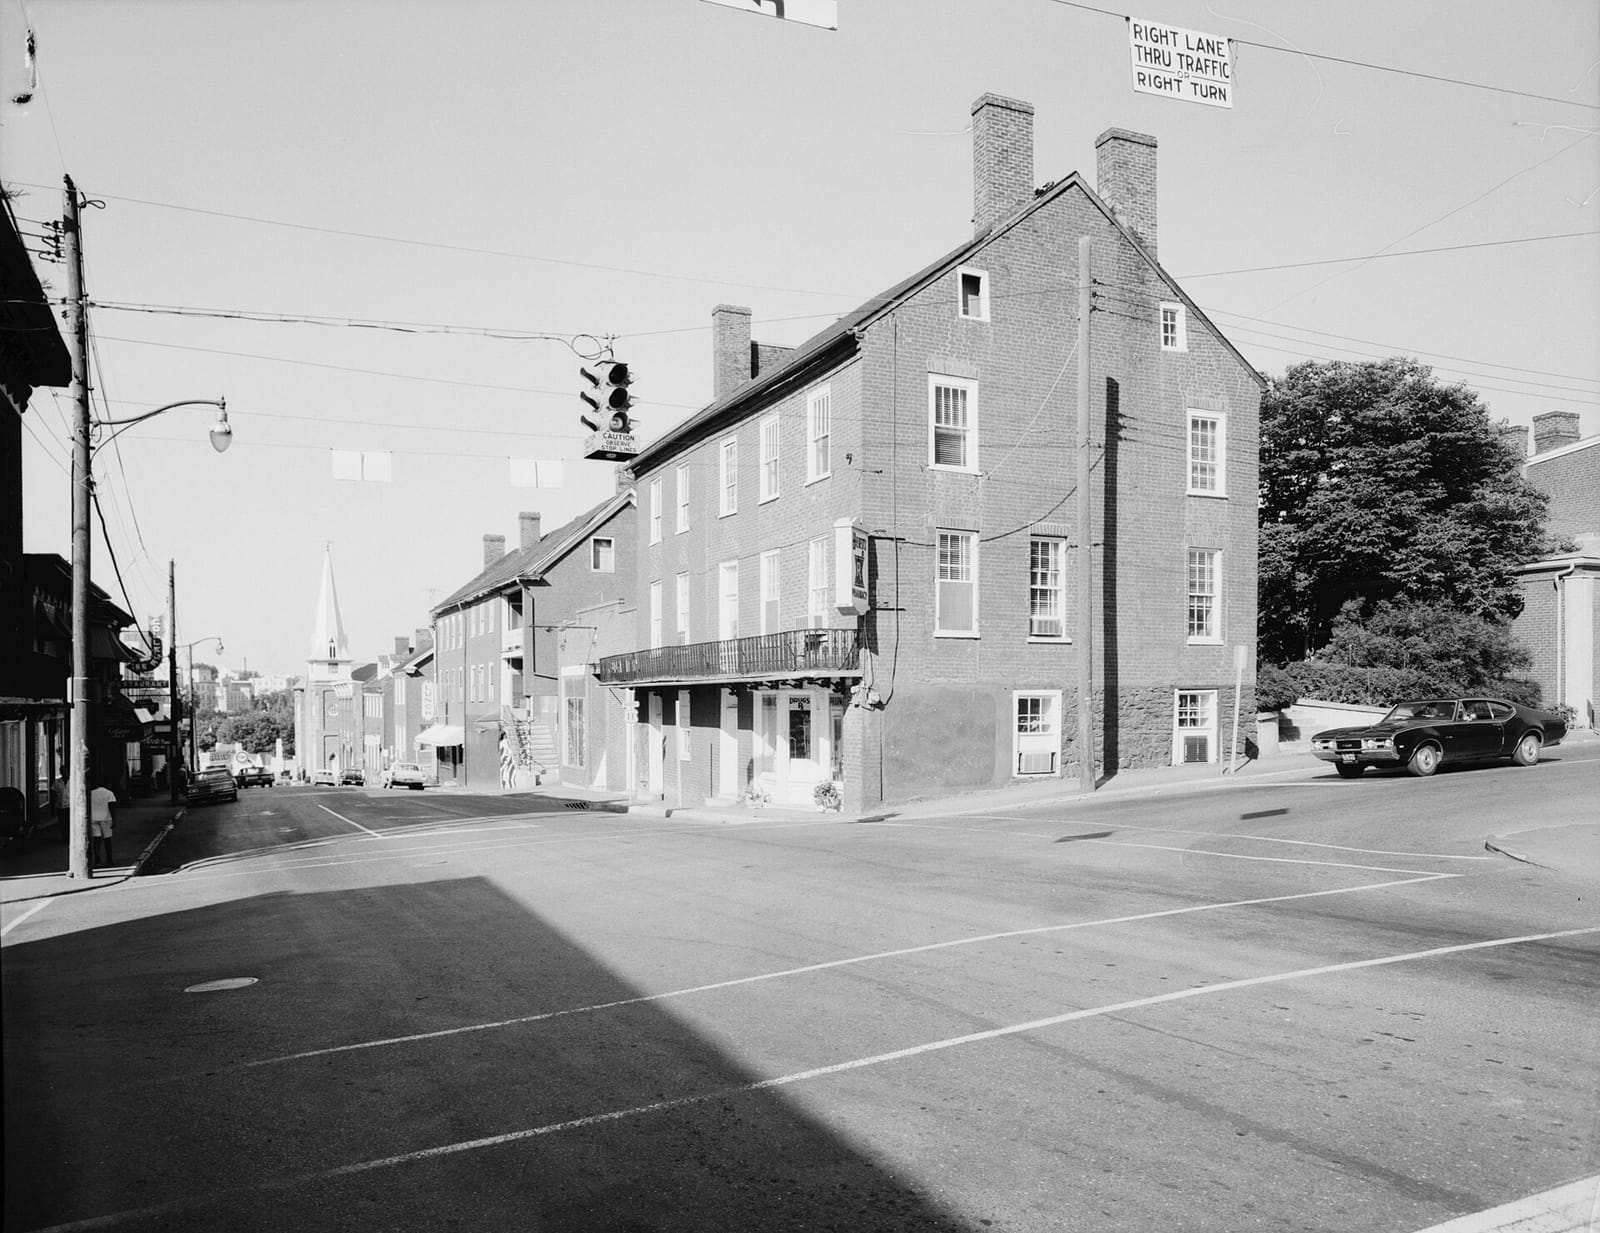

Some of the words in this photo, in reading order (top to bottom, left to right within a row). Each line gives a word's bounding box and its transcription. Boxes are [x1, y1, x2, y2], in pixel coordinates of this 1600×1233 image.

[1133, 23, 1179, 47] RIGHT
[1185, 34, 1225, 57] LANE
[1134, 44, 1172, 67] THRU
[1176, 53, 1230, 79] TRAFFIC
[1177, 70, 1190, 80] OR
[1137, 71, 1183, 92] RIGHT
[1190, 82, 1227, 102] TURN
[603, 432, 635, 441] CAUTION
